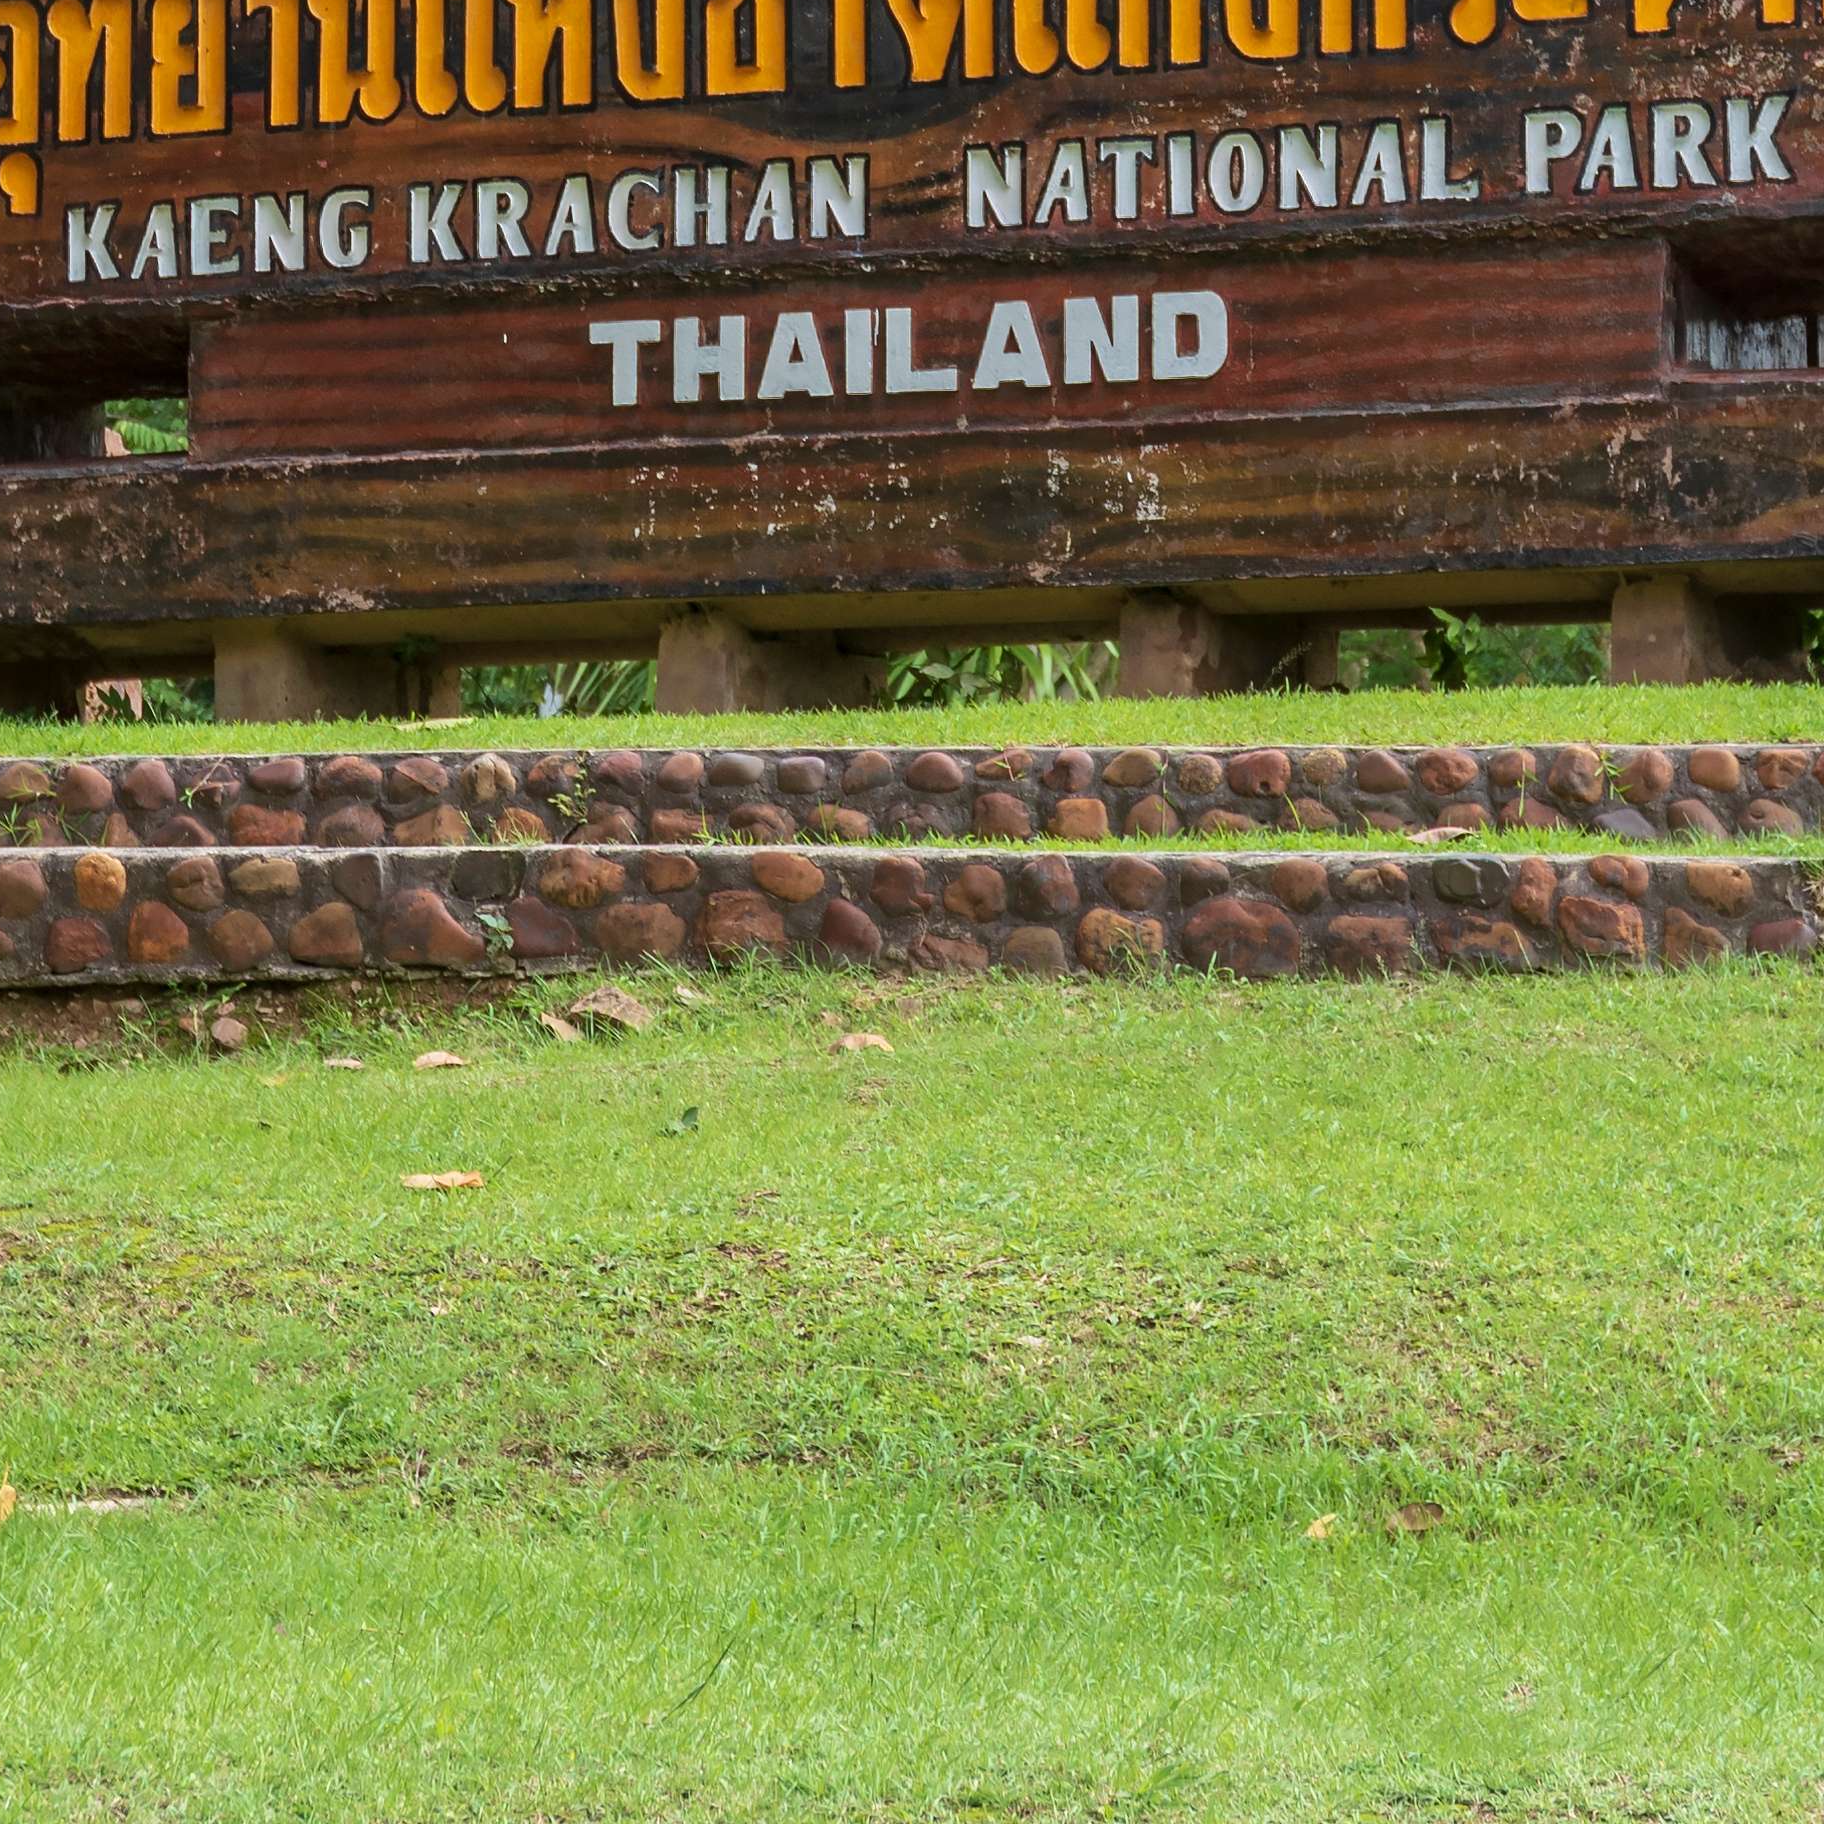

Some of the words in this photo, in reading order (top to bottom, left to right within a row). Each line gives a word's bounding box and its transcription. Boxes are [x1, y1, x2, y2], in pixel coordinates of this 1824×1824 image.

[66, 187, 374, 282] KAENG
[408, 154, 868, 265] KRACHAN
[964, 117, 1478, 228] NATIONAL
[1522, 93, 1795, 195] PARK
[588, 289, 1230, 406] THAILAND
